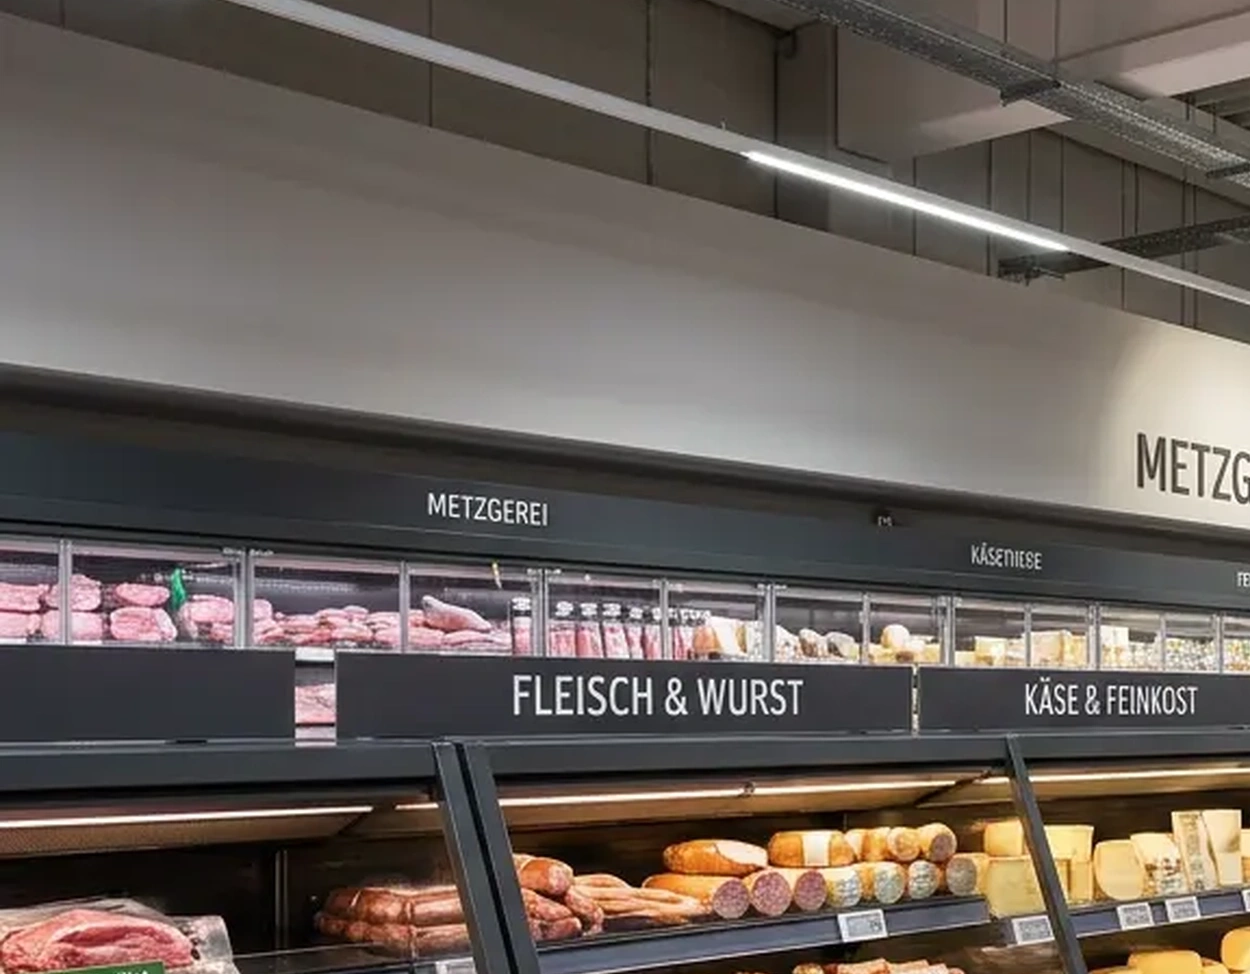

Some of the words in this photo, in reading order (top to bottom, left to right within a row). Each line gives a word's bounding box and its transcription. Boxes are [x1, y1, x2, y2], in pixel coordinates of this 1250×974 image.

[428, 492, 548, 526] METZGEREI
[513, 675, 652, 715] FLEISCH
[664, 677, 688, 716] &
[698, 678, 804, 716] WURST
[1025, 676, 1079, 715] KÄSE
[1084, 684, 1101, 715] &
[1107, 685, 1198, 715] FEINKOST
